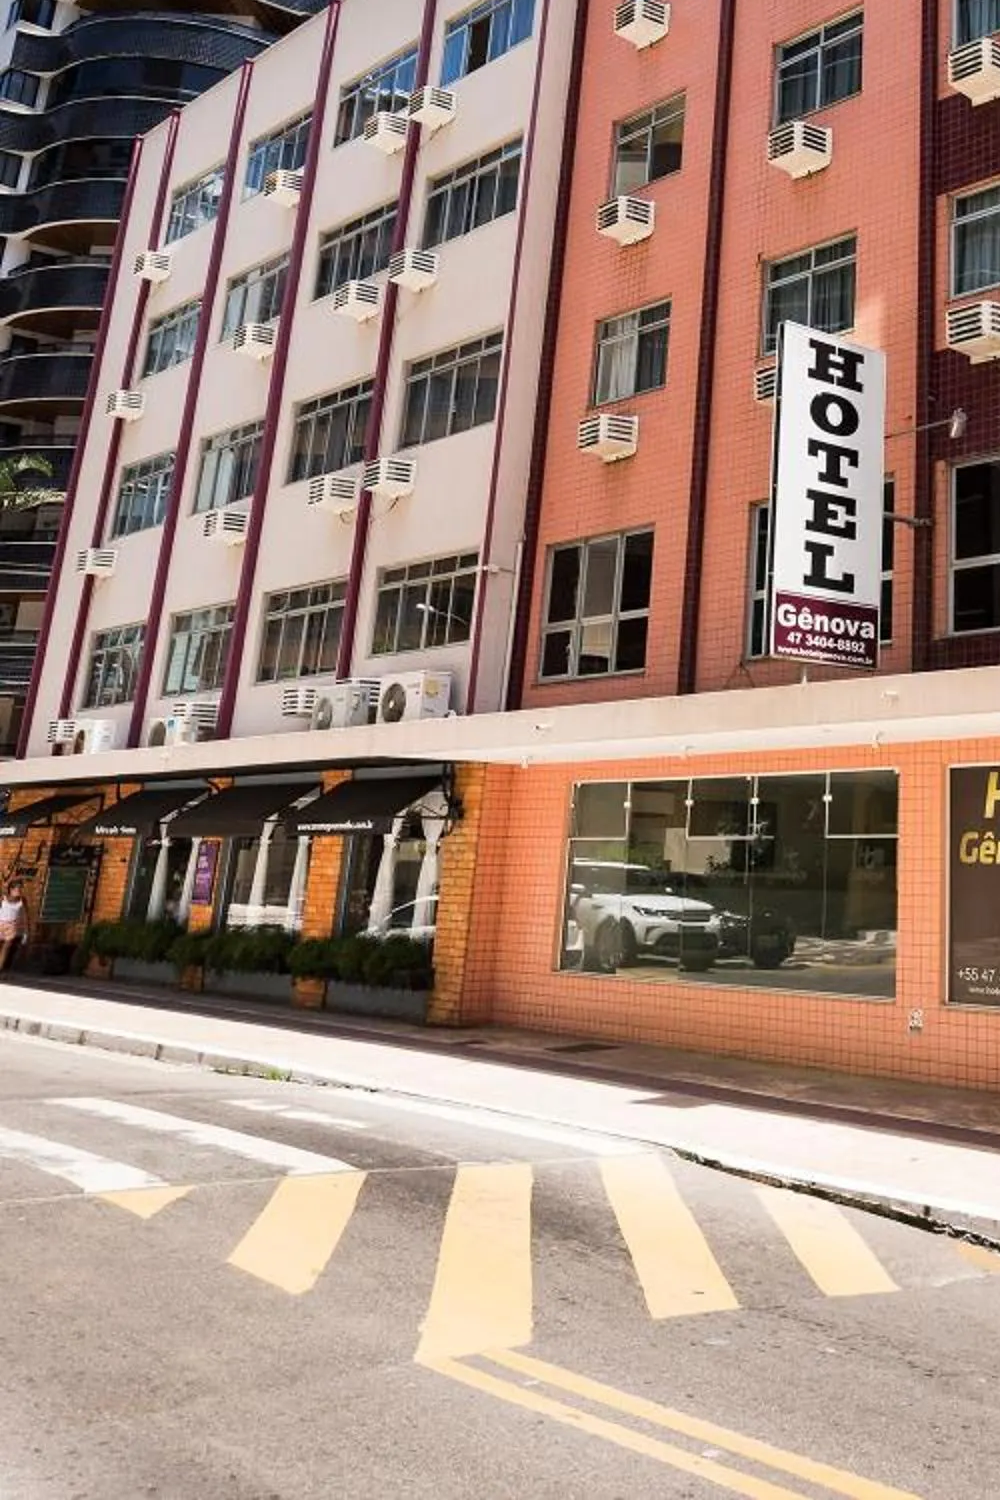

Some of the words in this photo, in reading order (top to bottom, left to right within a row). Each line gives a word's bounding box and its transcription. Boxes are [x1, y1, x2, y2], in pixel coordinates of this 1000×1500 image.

[803, 338, 865, 594] HOTEL
[777, 603, 875, 639] Gênova
[787, 631, 802, 644] 47
[957, 967, 979, 981] +55
[981, 968, 995, 982] 47
